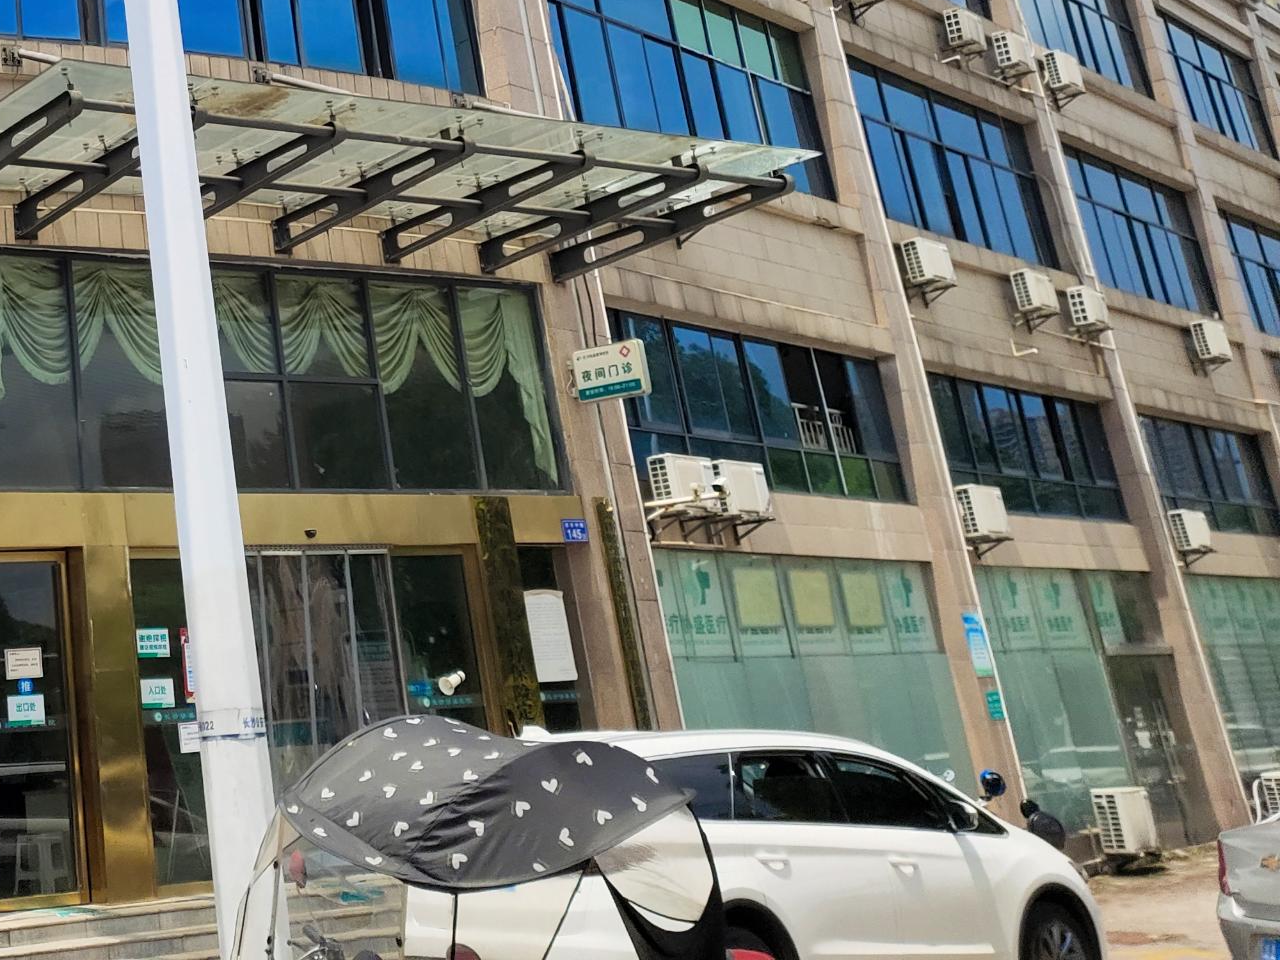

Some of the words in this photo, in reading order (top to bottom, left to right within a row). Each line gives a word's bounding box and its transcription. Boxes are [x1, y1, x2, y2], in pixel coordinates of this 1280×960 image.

[581, 361, 633, 382] 夜间门诊
[148, 685, 167, 695] 入口处
[15, 702, 37, 713] 出口处
